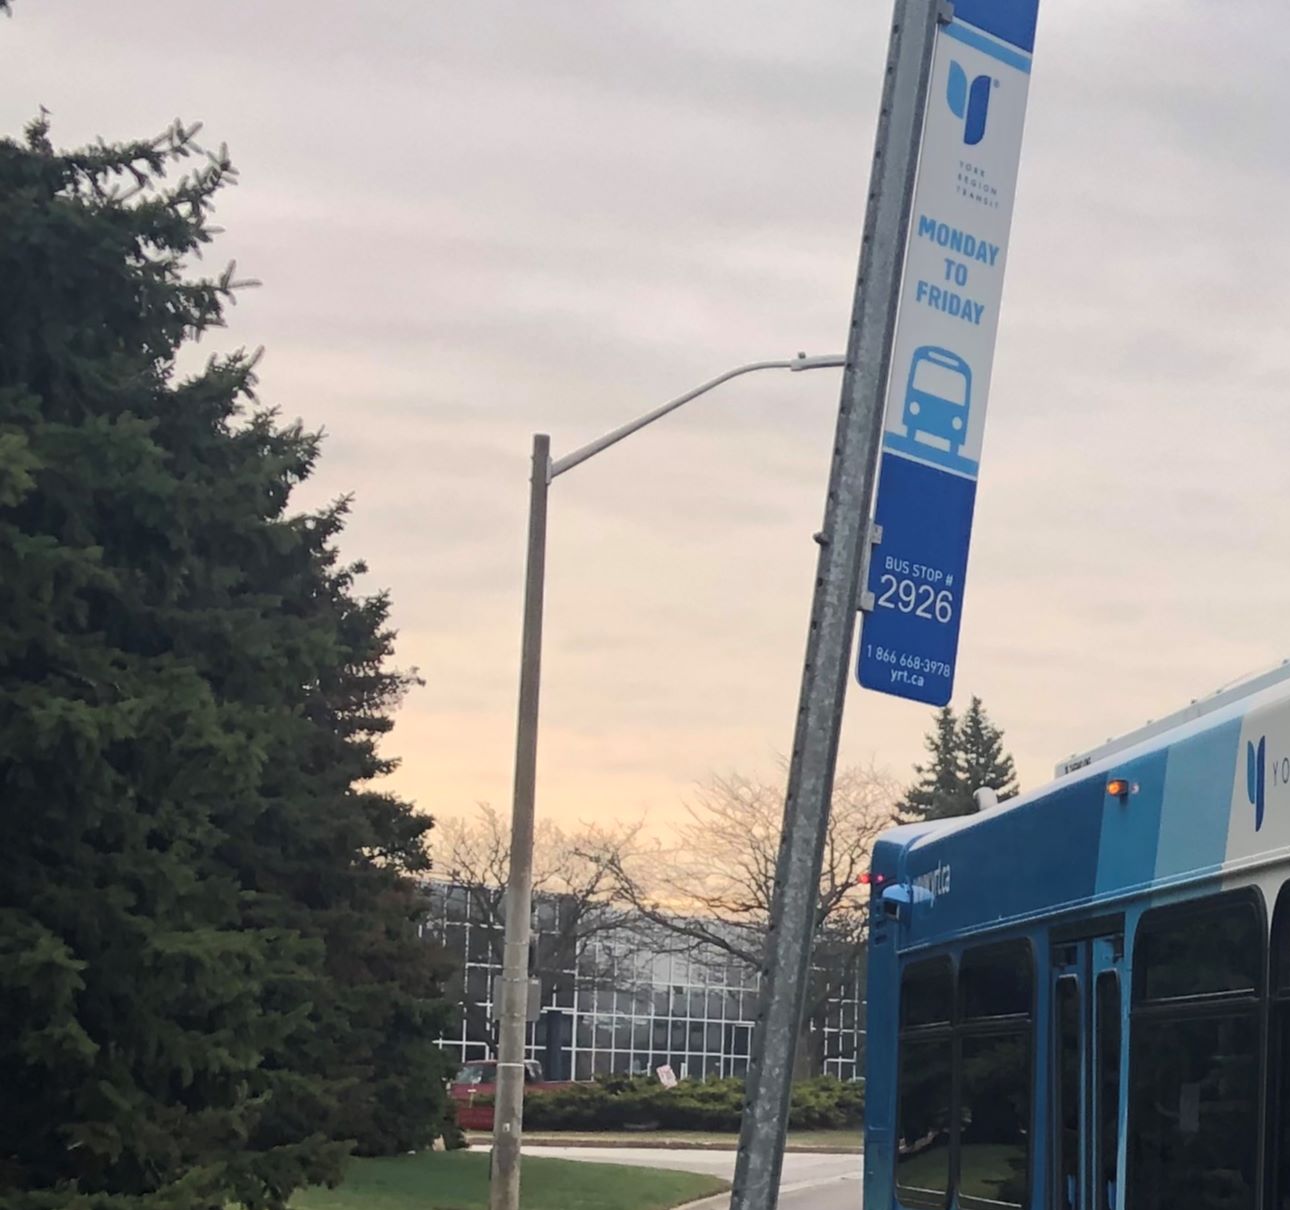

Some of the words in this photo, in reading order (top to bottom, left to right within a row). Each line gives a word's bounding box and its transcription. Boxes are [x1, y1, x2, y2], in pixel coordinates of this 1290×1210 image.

[957, 172, 998, 196] REGION
[959, 160, 985, 178] YORK
[918, 214, 999, 267] MONDAY
[944, 258, 968, 287] TO
[916, 280, 985, 325] FRIDAY
[885, 556, 910, 575] BUS
[912, 564, 943, 583] STOP
[945, 574, 954, 587] #
[878, 574, 953, 624] 2926
[867, 644, 872, 658] 1
[875, 646, 897, 664] 866
[899, 653, 951, 678] 668-3978
[890, 669, 925, 687] yrt.ca
